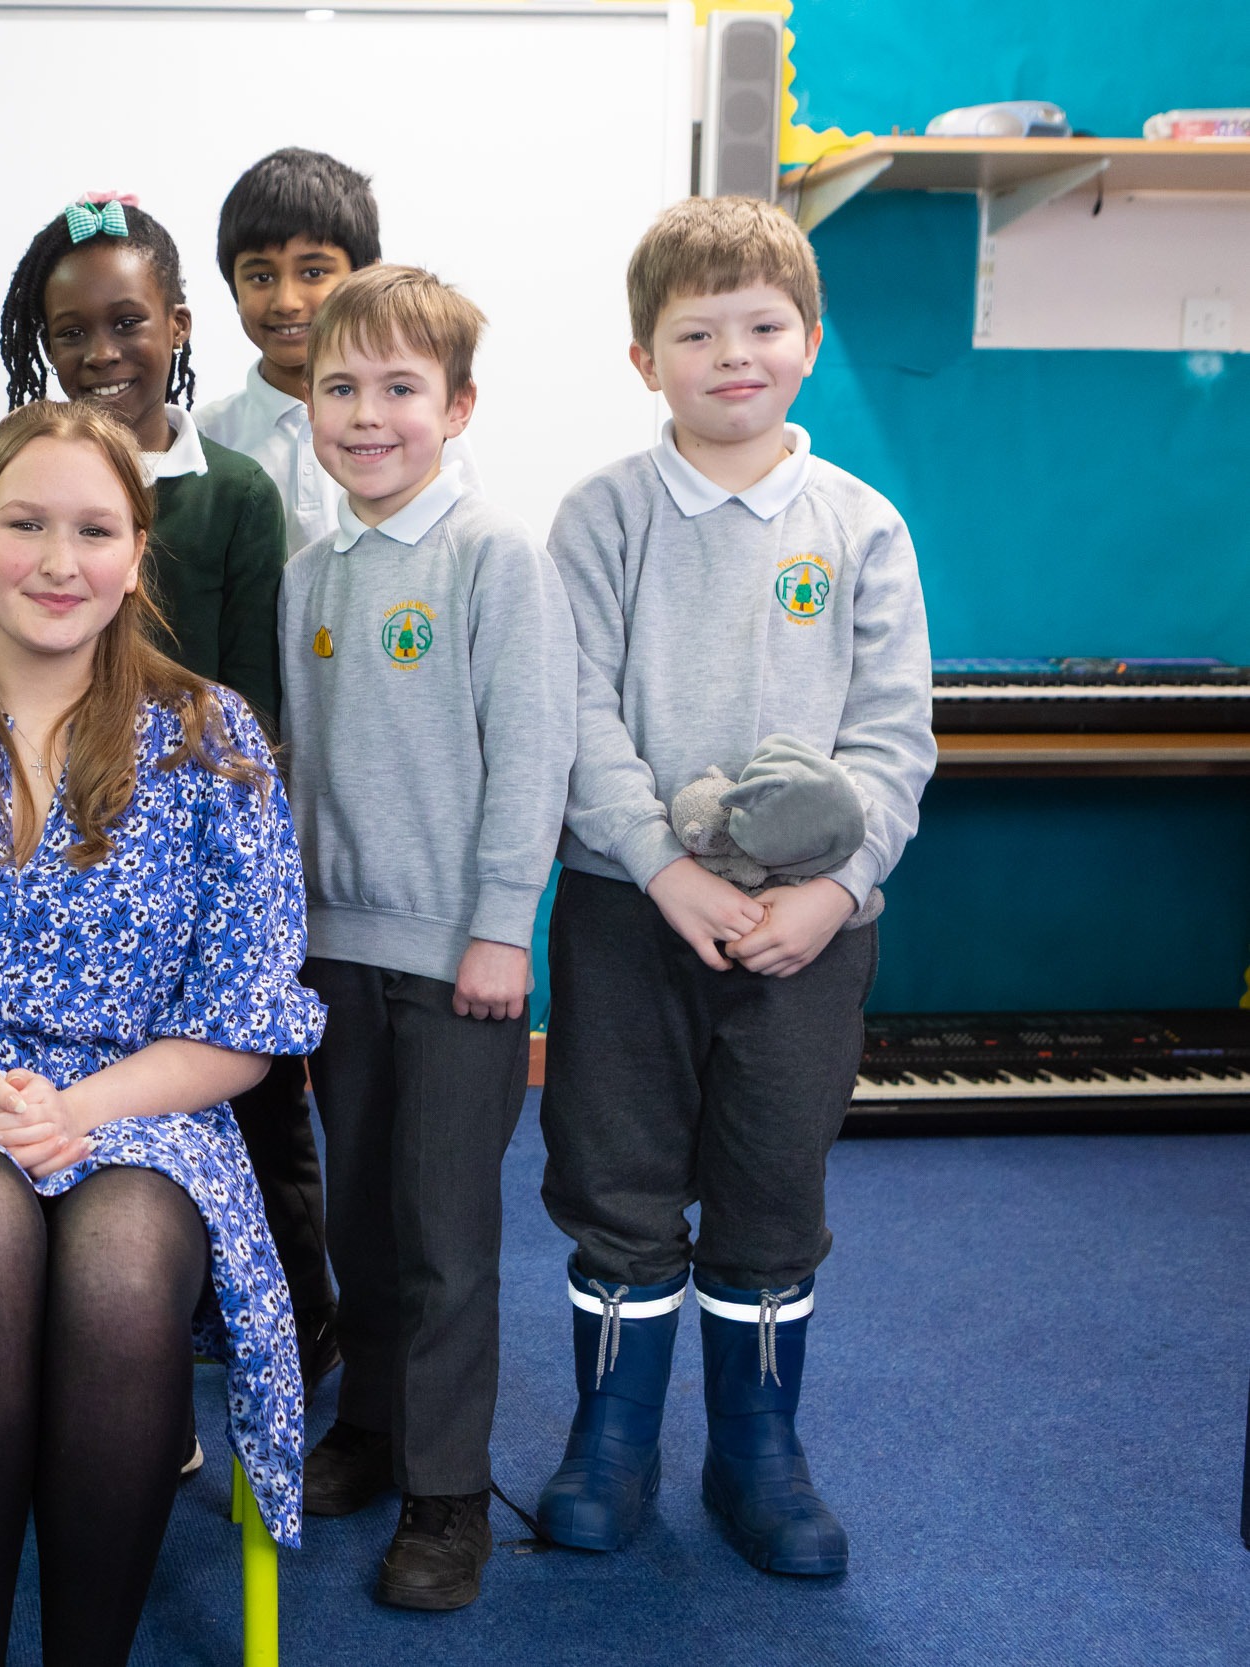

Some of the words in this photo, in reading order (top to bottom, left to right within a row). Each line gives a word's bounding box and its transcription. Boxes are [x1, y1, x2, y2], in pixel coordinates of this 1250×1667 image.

[782, 576, 797, 600] F
[814, 581, 829, 606] S
[387, 624, 401, 649] F
[416, 624, 430, 650] S
